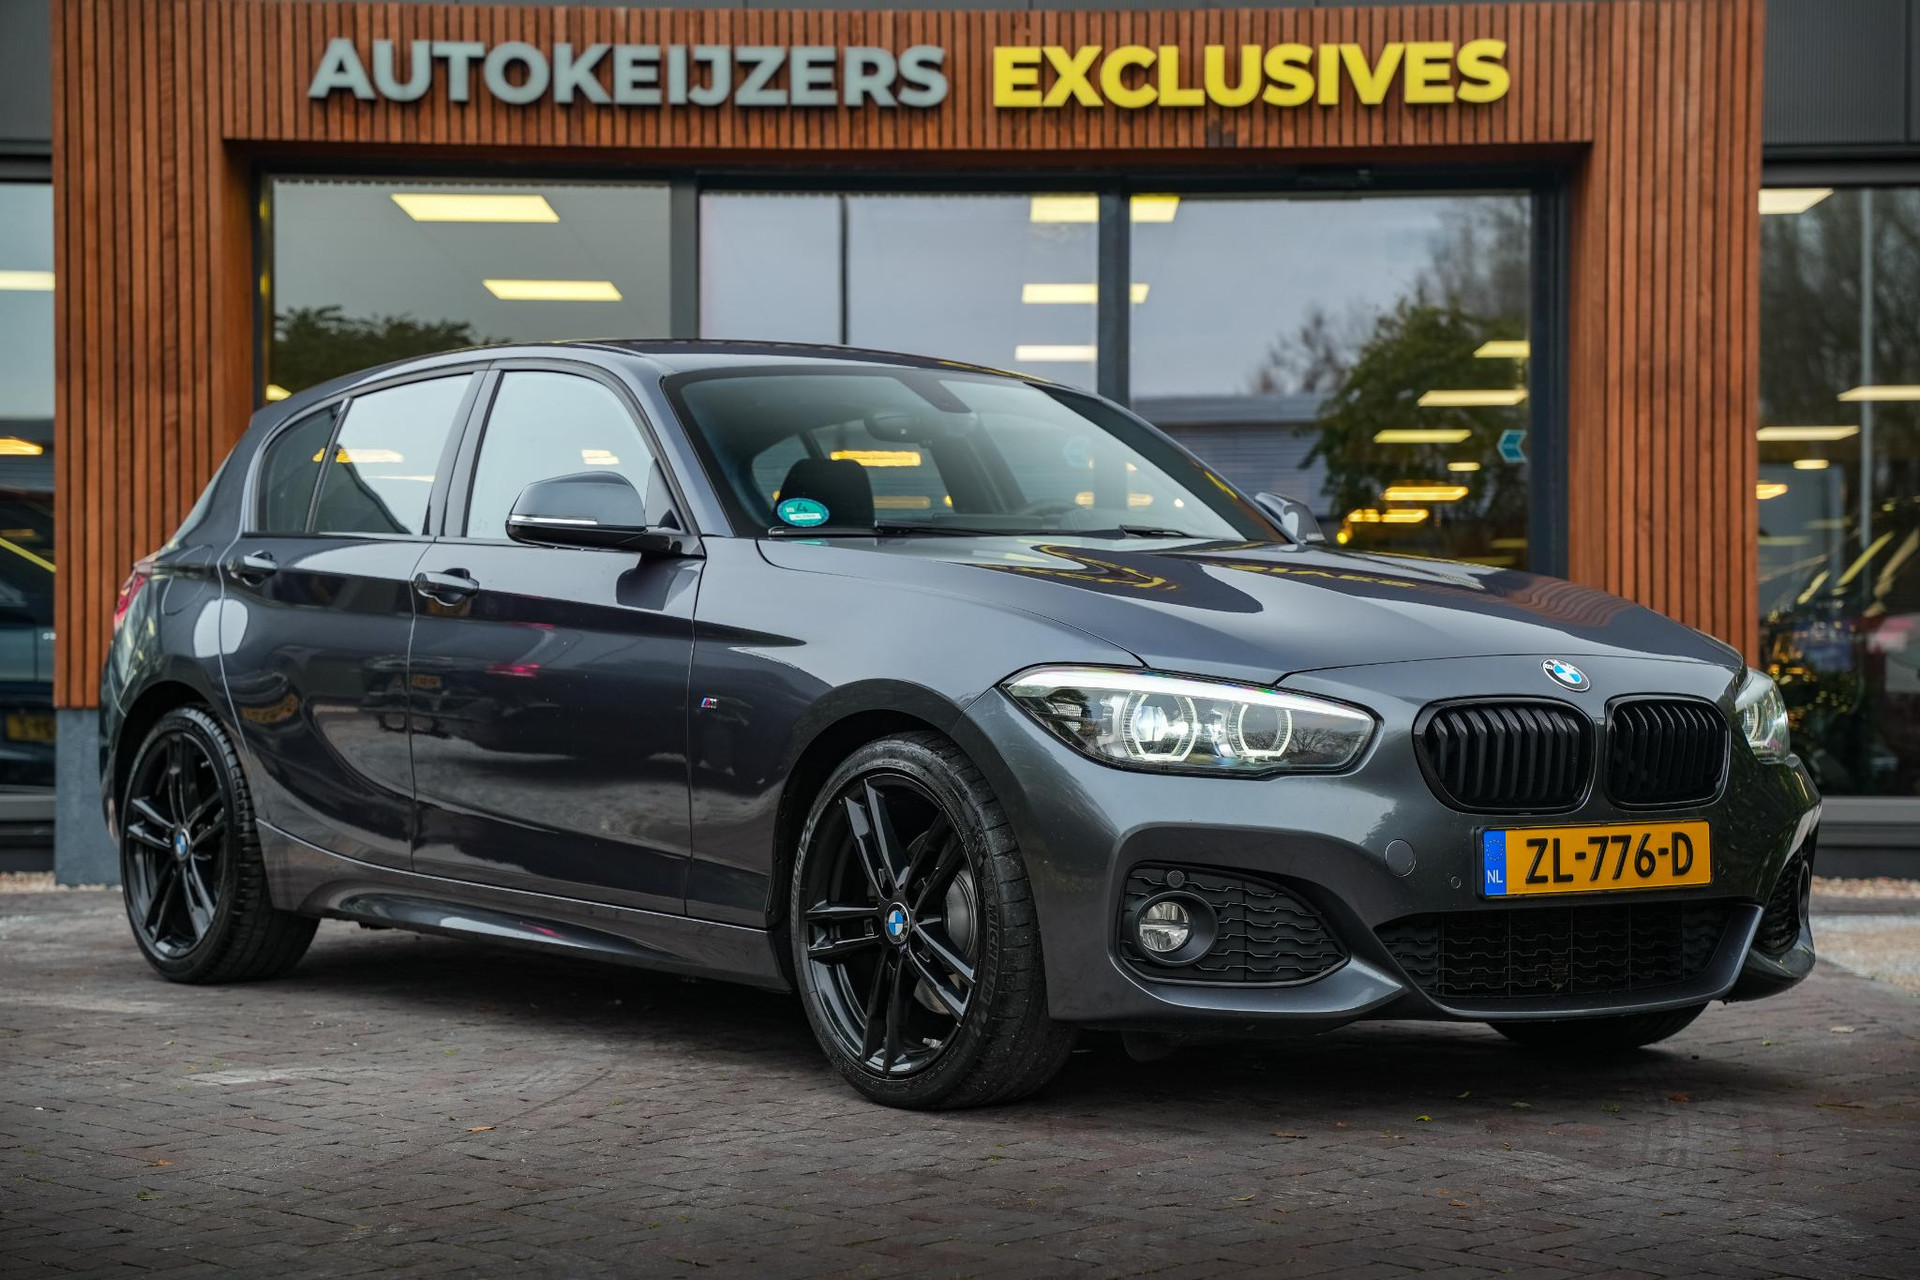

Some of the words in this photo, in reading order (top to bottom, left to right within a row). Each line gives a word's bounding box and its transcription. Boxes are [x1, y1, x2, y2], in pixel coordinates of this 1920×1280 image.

[307, 38, 948, 107] AUTOKEIJZERS
[994, 39, 1510, 107] EXCLUSIVES
[1486, 870, 1503, 884] NL
[1526, 832, 1694, 884] ZL-776-D
[980, 904, 999, 1005] MICHELIN
